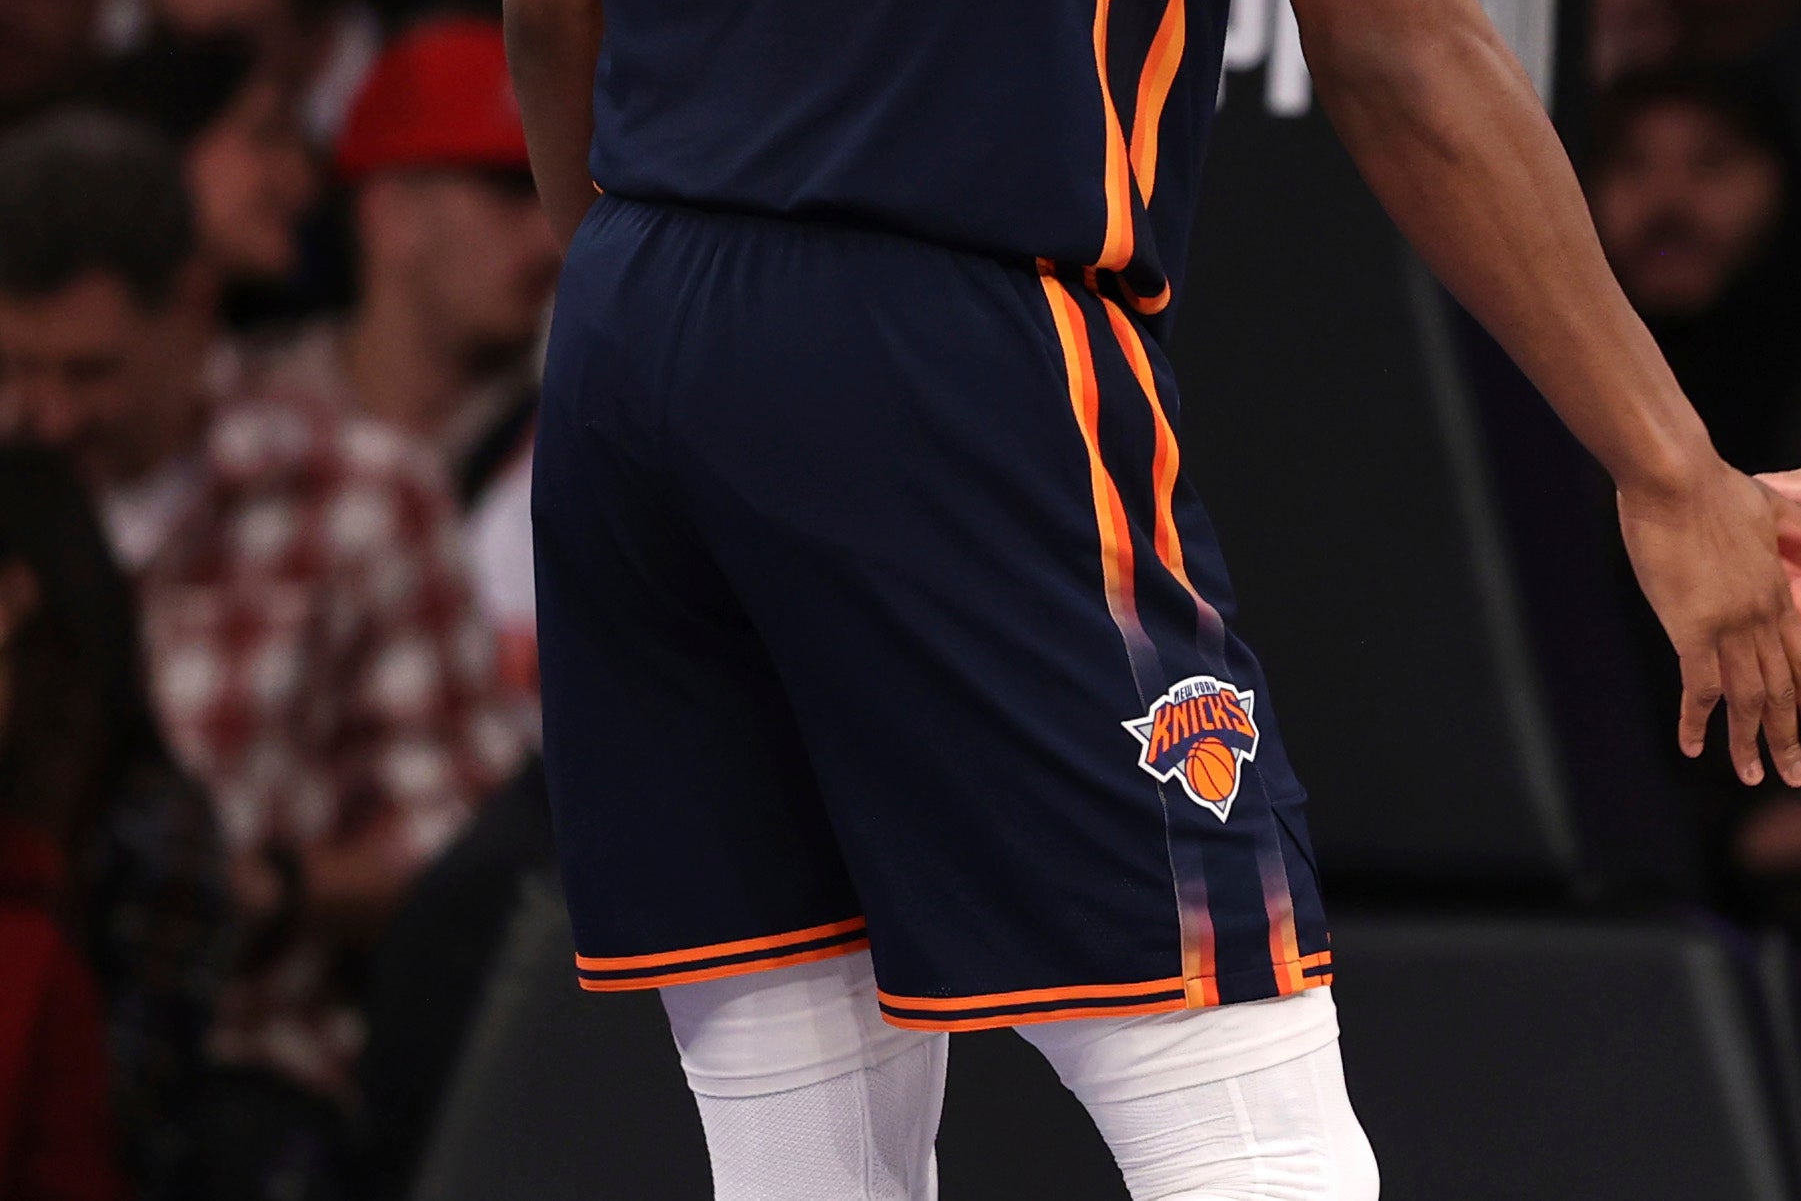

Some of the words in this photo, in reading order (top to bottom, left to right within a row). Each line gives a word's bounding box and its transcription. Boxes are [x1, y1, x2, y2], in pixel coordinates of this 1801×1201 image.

[1173, 684, 1193, 703] NEW
[1193, 681, 1217, 697] YORK
[1146, 689, 1255, 764] KNICKS
